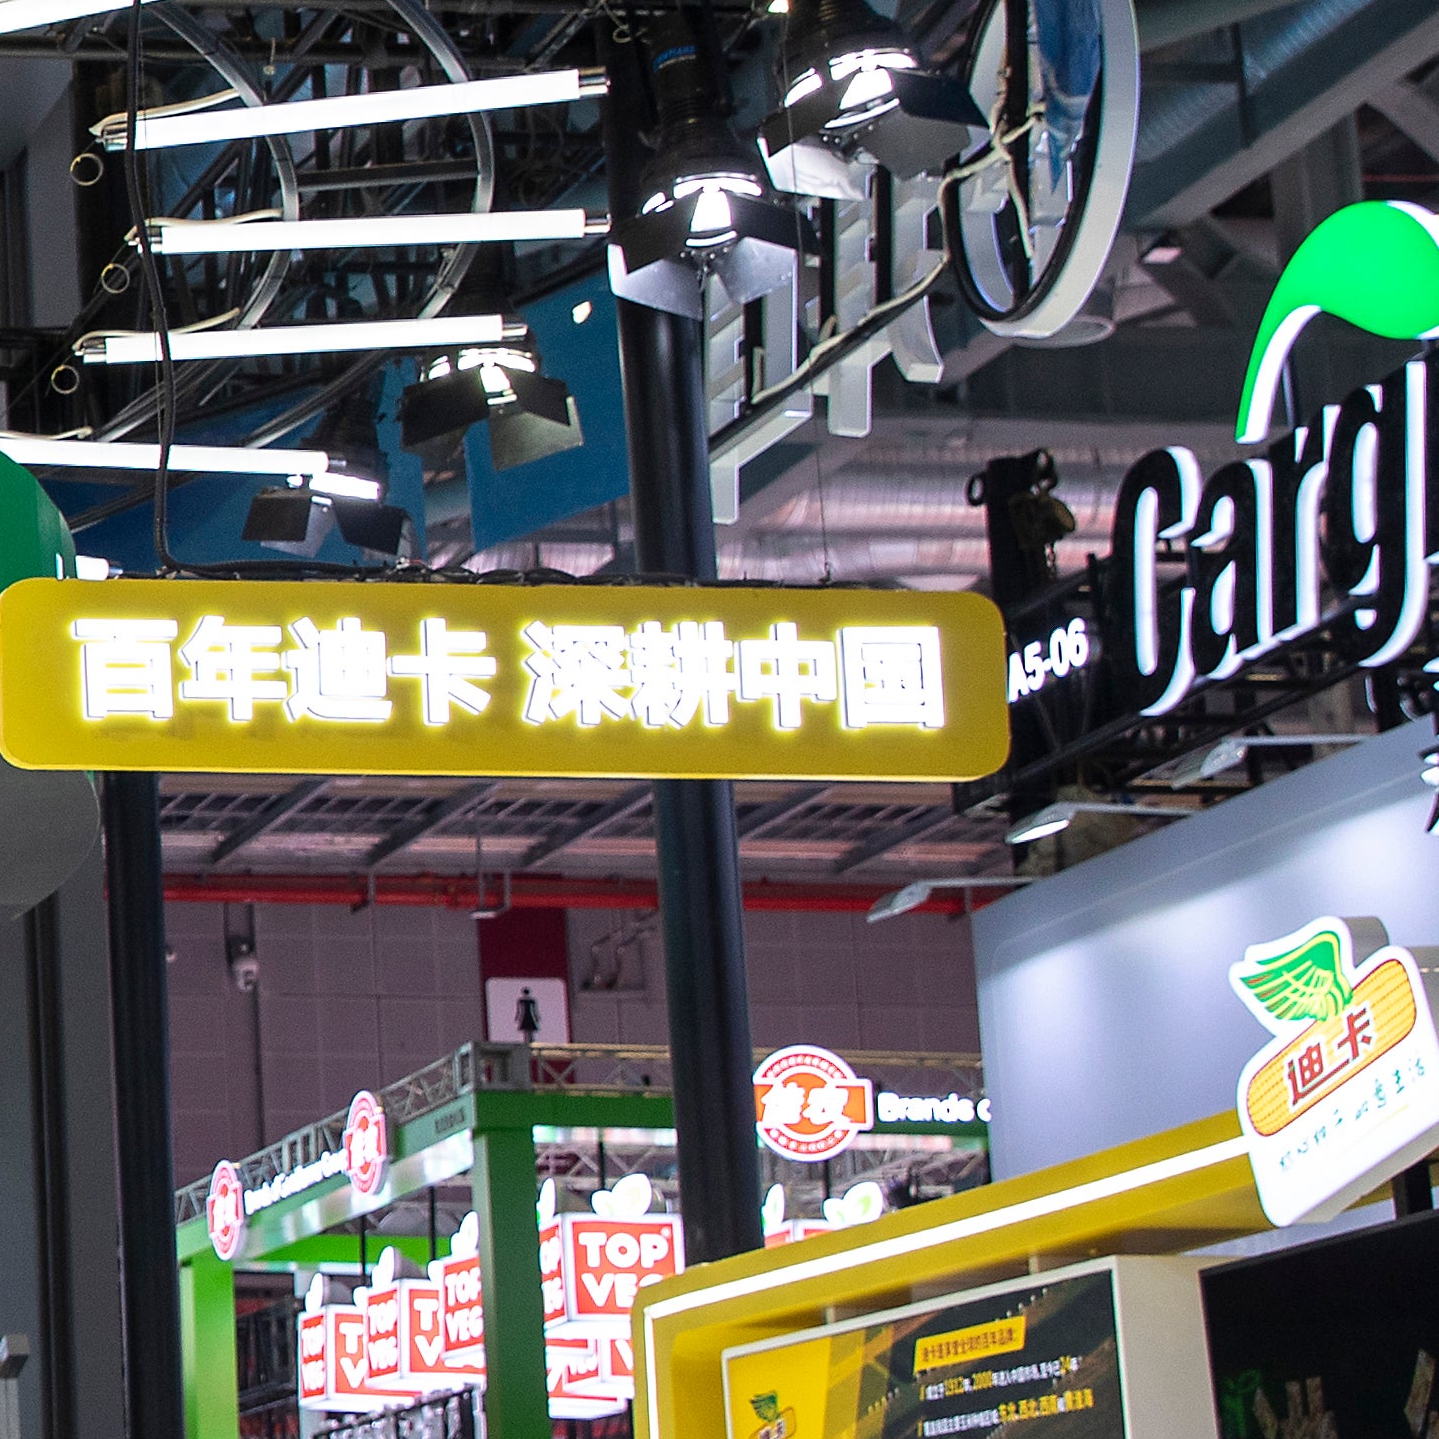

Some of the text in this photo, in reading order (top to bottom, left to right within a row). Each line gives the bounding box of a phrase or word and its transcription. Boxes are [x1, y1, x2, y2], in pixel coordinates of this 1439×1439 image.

[72, 613, 947, 732] 百年迪卡 深耕中国
[1285, 1005, 1375, 1108] 迪卡
[579, 1231, 670, 1269] TOP
